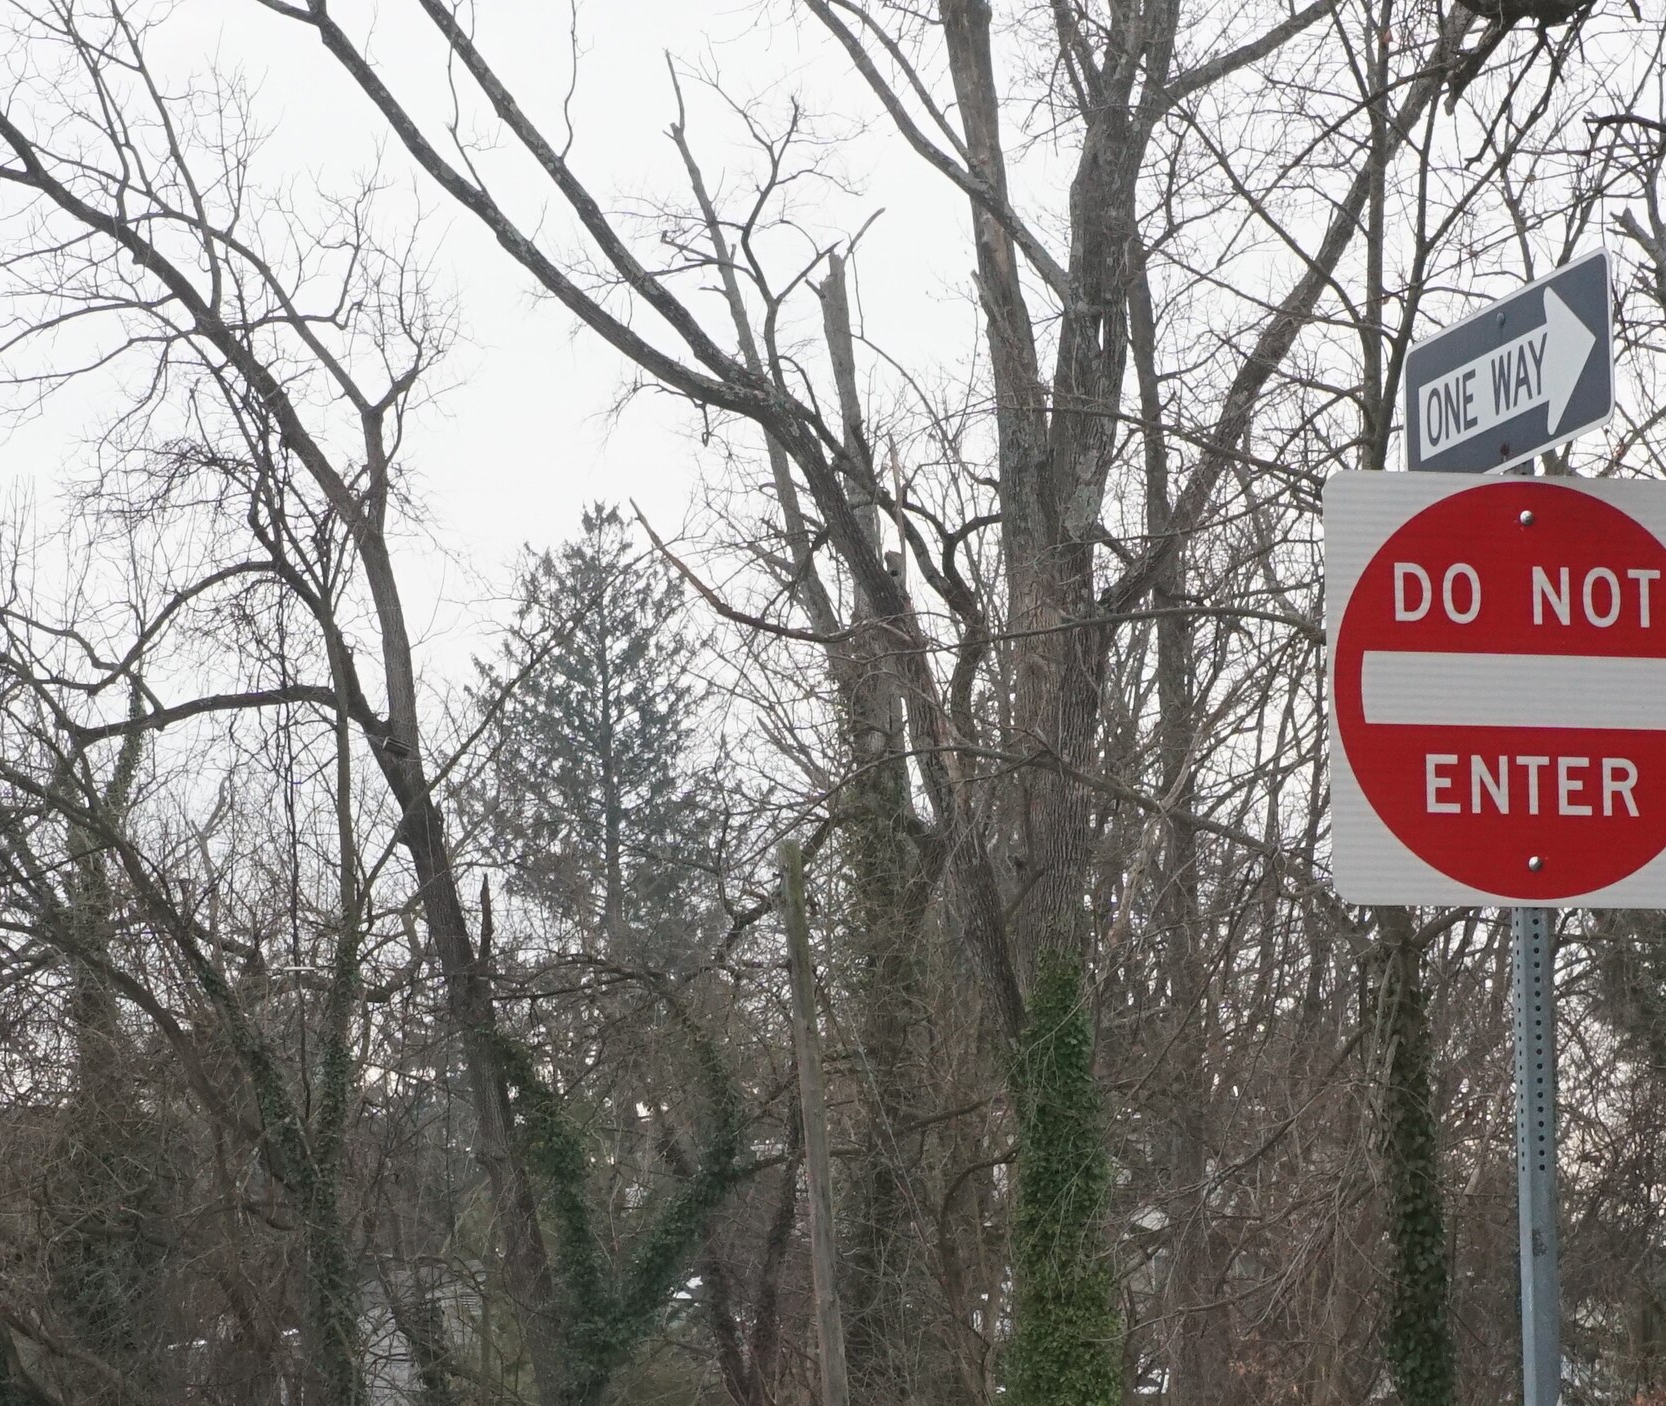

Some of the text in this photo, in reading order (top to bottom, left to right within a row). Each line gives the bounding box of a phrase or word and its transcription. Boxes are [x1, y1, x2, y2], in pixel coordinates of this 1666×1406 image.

[1427, 331, 1548, 447] ONE WAY
[1394, 562, 1661, 628] DO NOT
[1425, 753, 1640, 817] ENTER
